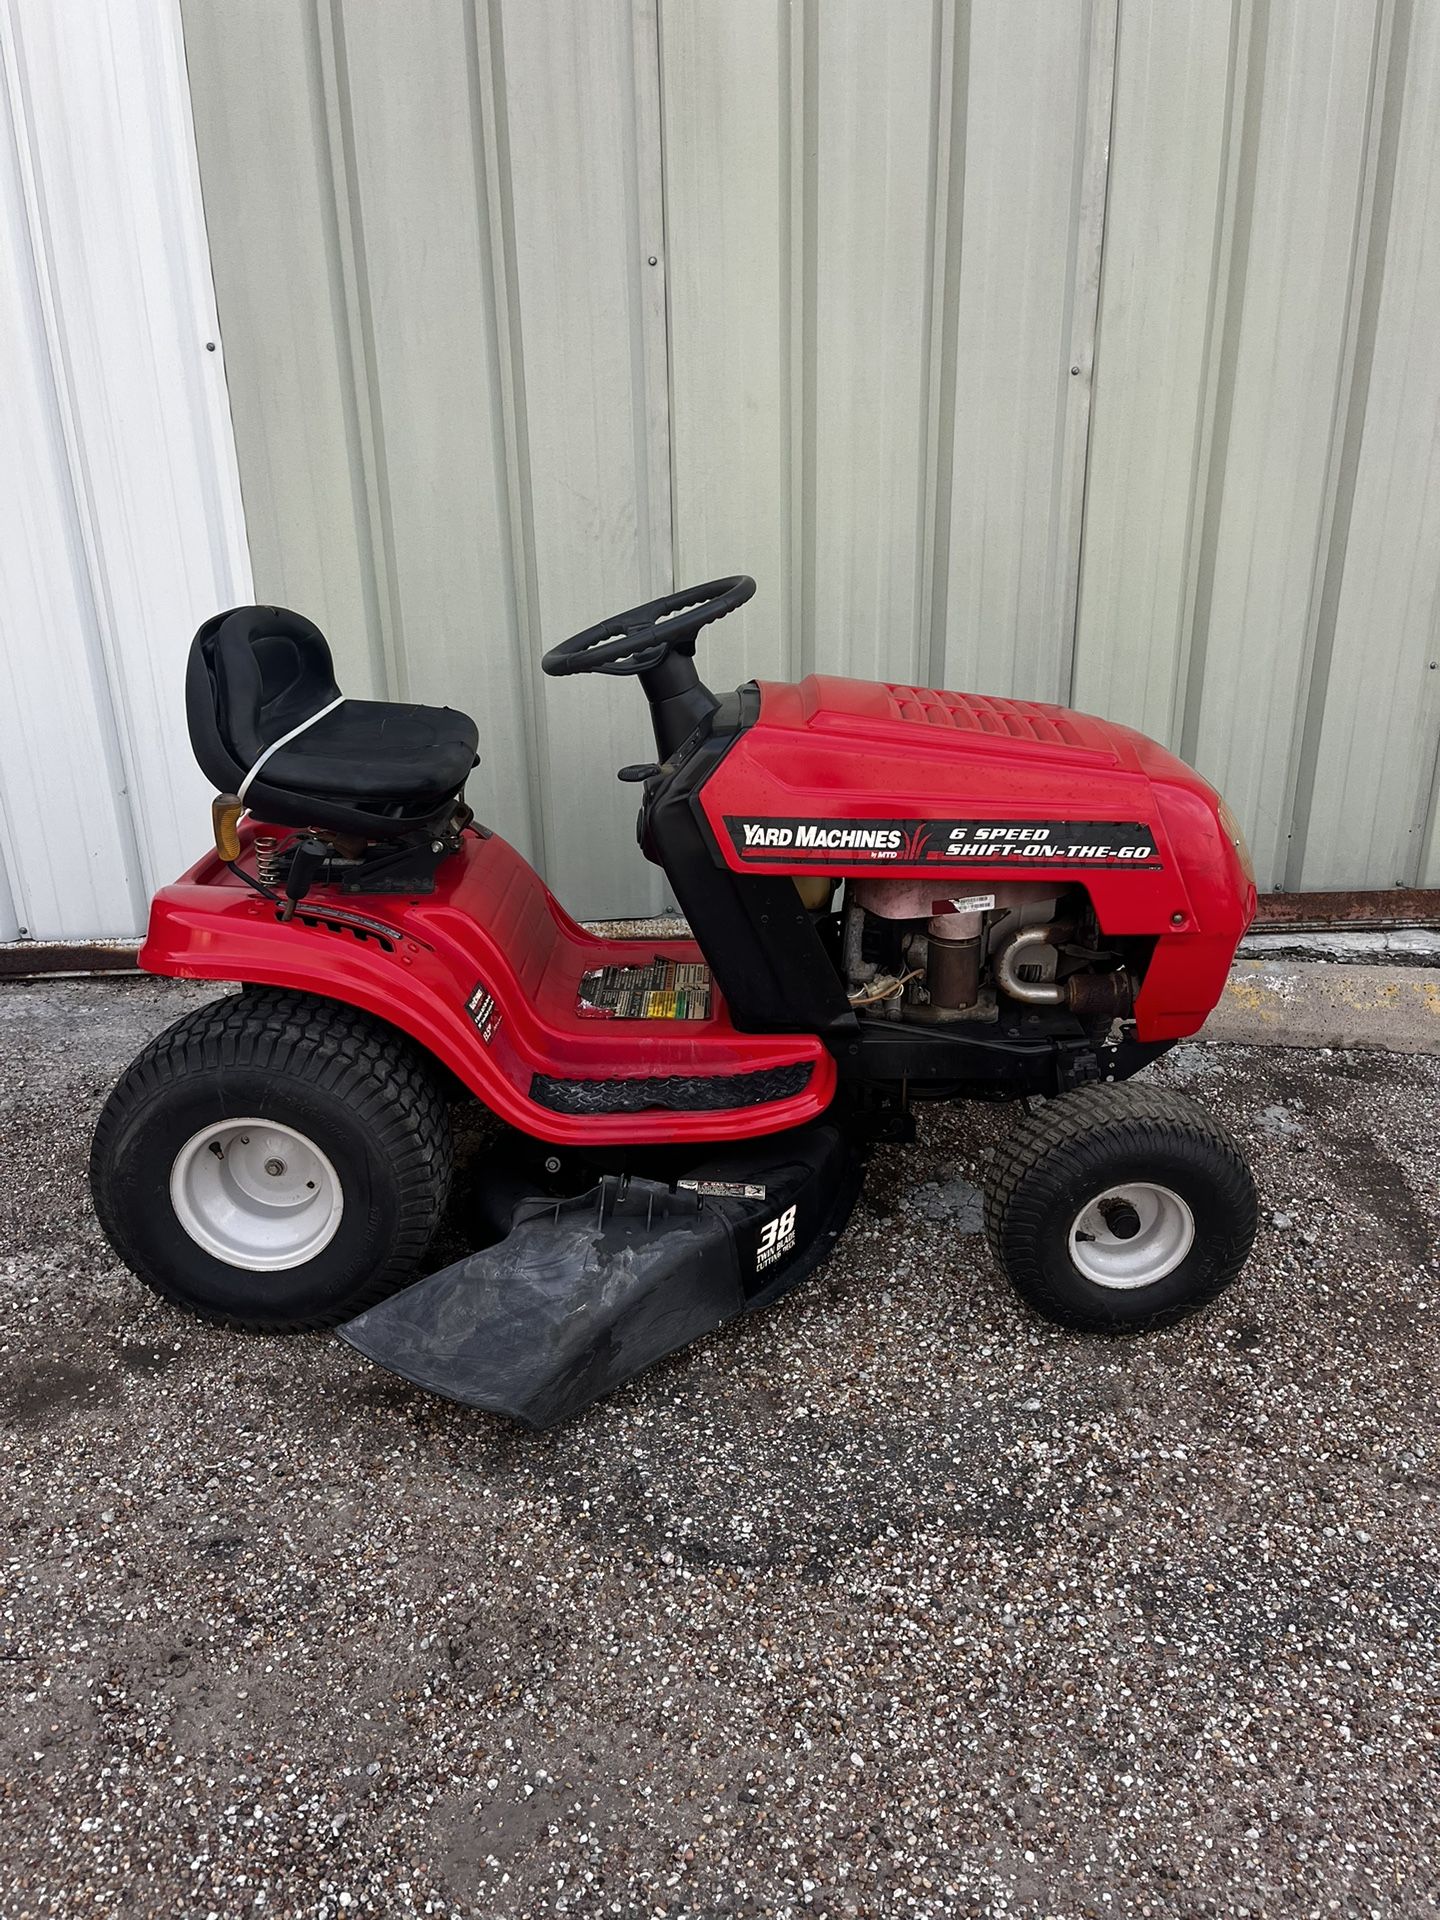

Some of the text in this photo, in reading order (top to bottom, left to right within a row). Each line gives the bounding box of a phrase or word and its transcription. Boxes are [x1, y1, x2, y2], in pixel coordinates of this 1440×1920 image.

[743, 824, 902, 848] YARD MACHINES
[949, 828, 1050, 841] 6 SPEED
[878, 851, 898, 859] MTD
[946, 843, 1151, 859] SHIFT-ON-THE-GO
[756, 1204, 797, 1255] 38
[757, 1229, 796, 1264] TWIN BLADE
[756, 1250, 782, 1272] CUTTING
